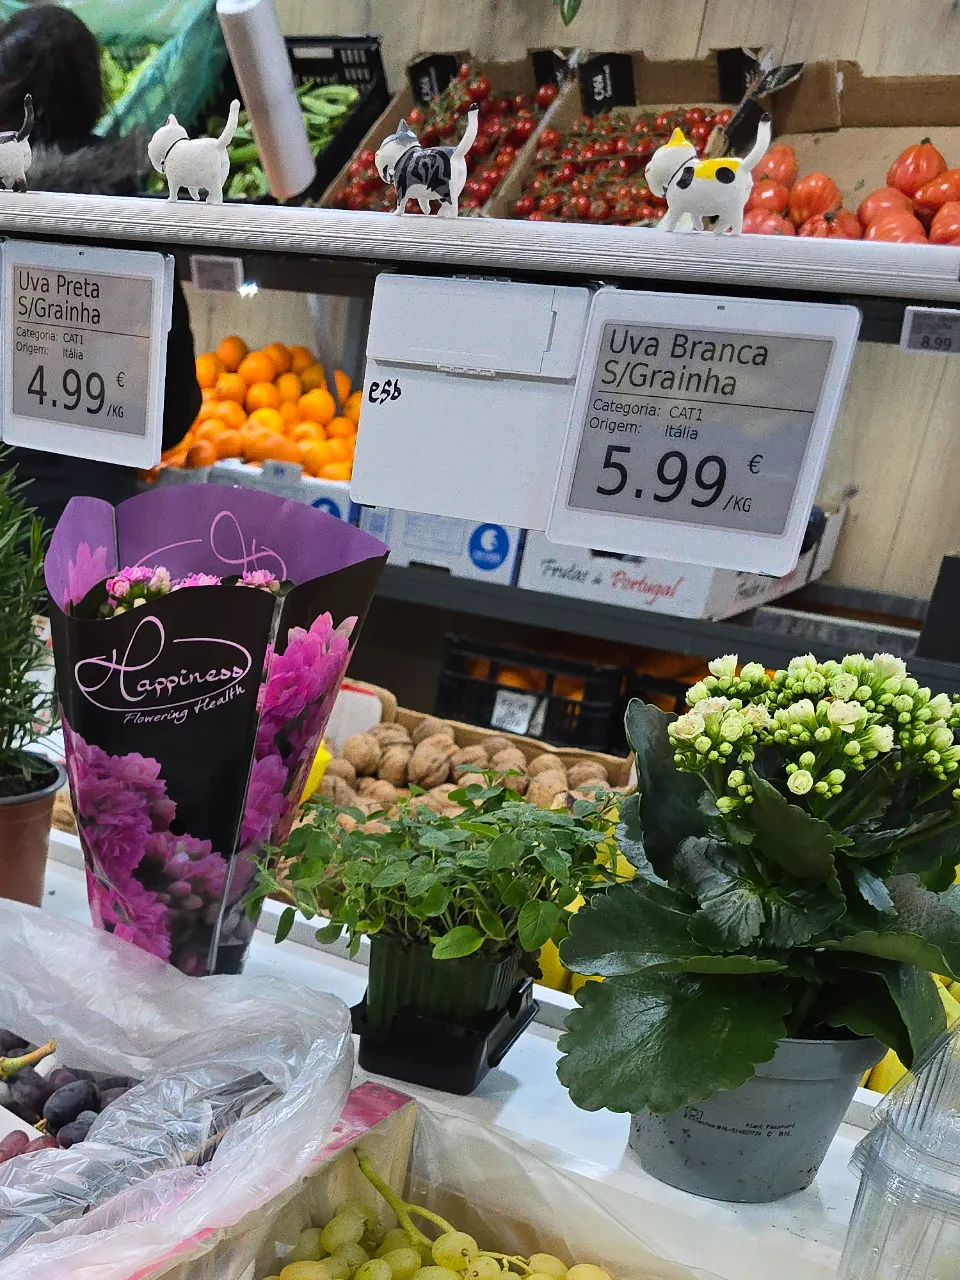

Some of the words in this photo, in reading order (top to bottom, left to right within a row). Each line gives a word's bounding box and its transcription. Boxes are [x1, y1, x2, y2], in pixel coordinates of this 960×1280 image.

[19, 270, 50, 293] Uva
[57, 274, 100, 299] Preta
[18, 296, 101, 325] S/Grainha
[16, 326, 58, 341] Categoria:
[63, 332, 84, 346] CAT1
[16, 341, 49, 356] Origem:
[63, 348, 84, 360] Itália
[609, 328, 660, 357] Uva
[670, 333, 769, 367] Branca
[27, 365, 106, 415] 4.99
[116, 371, 126, 388] €
[601, 359, 737, 397] S/Grainha
[107, 404, 124, 418] /KG
[592, 398, 661, 418] Categoria:
[669, 405, 703, 422] CAT1
[589, 416, 642, 436] Origem:
[665, 424, 699, 441] Itália
[595, 444, 727, 508] 5.99
[747, 454, 764, 475] €
[722, 494, 752, 513] /KG
[611, 569, 686, 606] Portugal
[75, 615, 247, 706] Happiness
[123, 708, 189, 725] Flowering
[194, 683, 246, 715] Health
